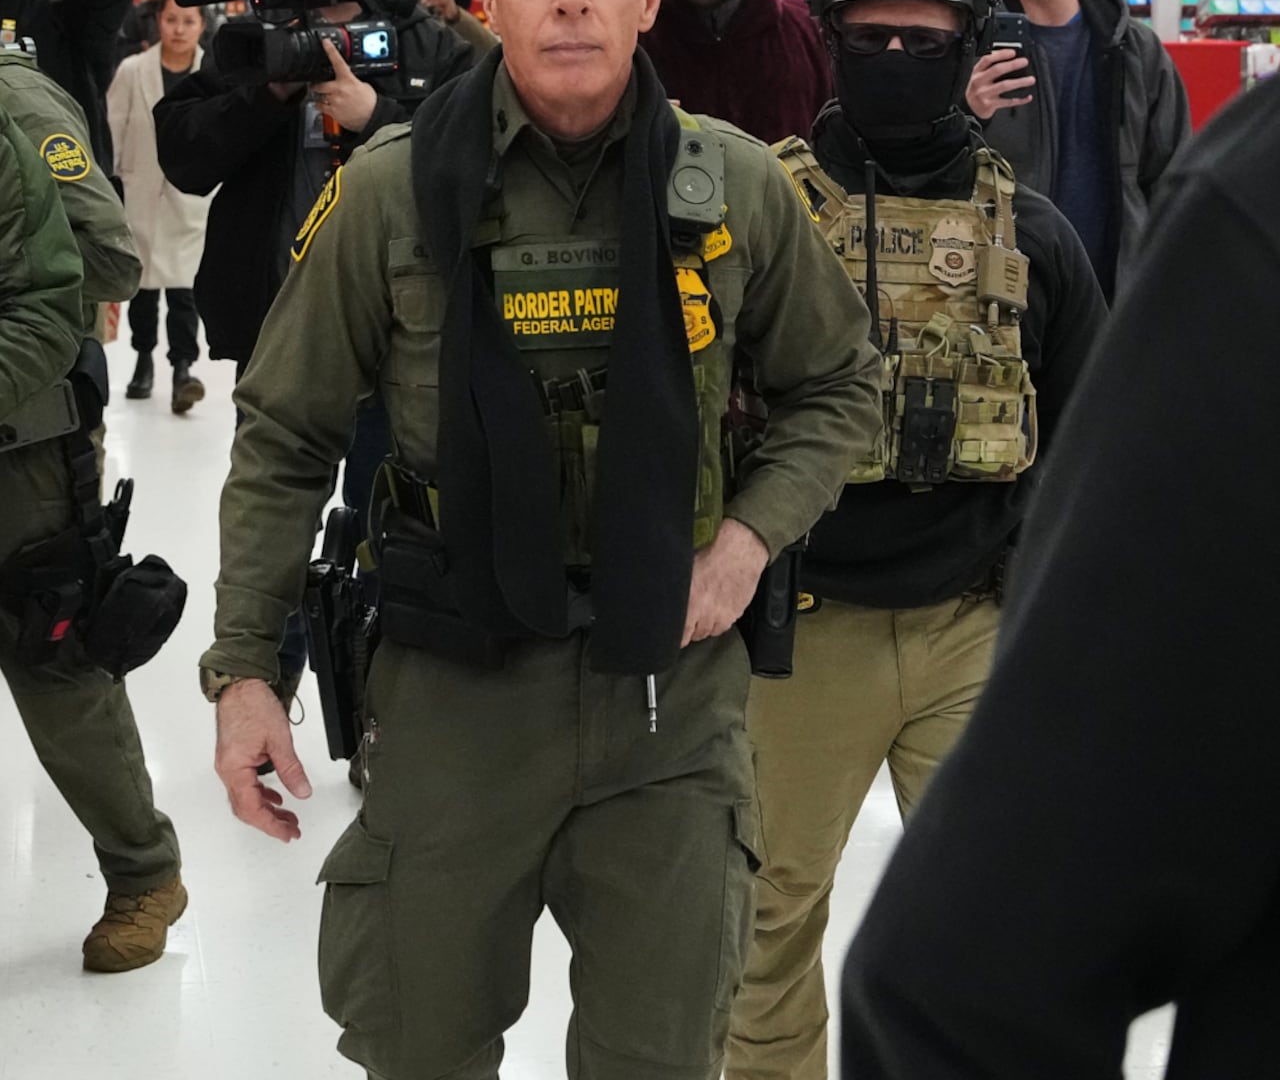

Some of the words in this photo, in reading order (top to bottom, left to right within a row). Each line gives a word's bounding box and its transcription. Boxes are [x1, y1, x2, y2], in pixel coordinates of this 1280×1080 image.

[850, 224, 924, 255] PLICE
[521, 251, 539, 266] G.
[546, 247, 618, 265] BOVINO
[503, 290, 572, 320] BORDER
[513, 318, 579, 335] FEDERAL
